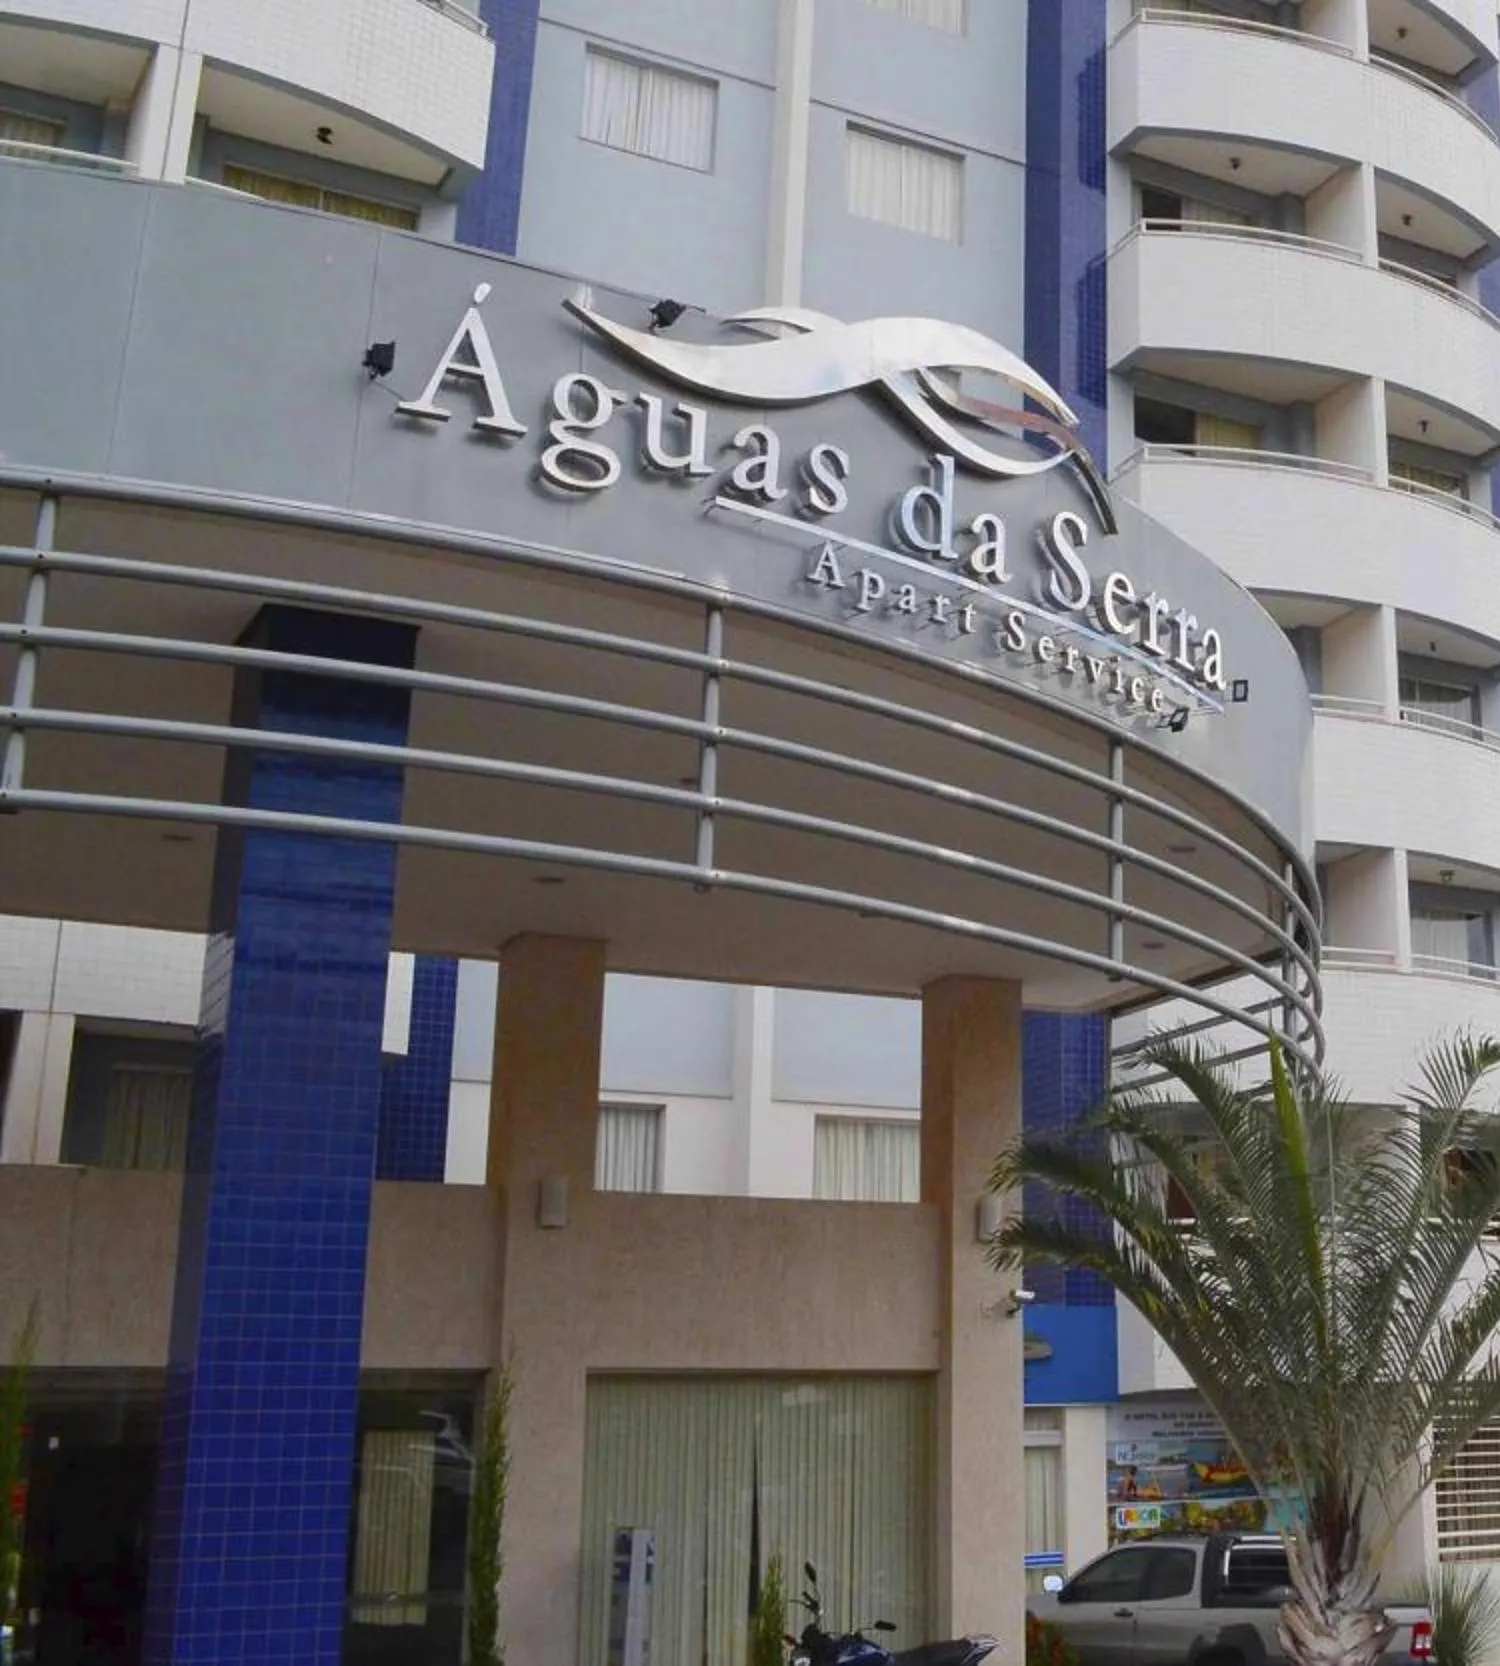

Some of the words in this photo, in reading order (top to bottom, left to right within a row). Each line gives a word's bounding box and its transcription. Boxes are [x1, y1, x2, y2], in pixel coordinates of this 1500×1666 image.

[395, 282, 849, 513] Águas
[900, 453, 1012, 584] da
[1050, 511, 1226, 691] Serra
[807, 540, 977, 634] Apart
[1007, 611, 1164, 711] Service
